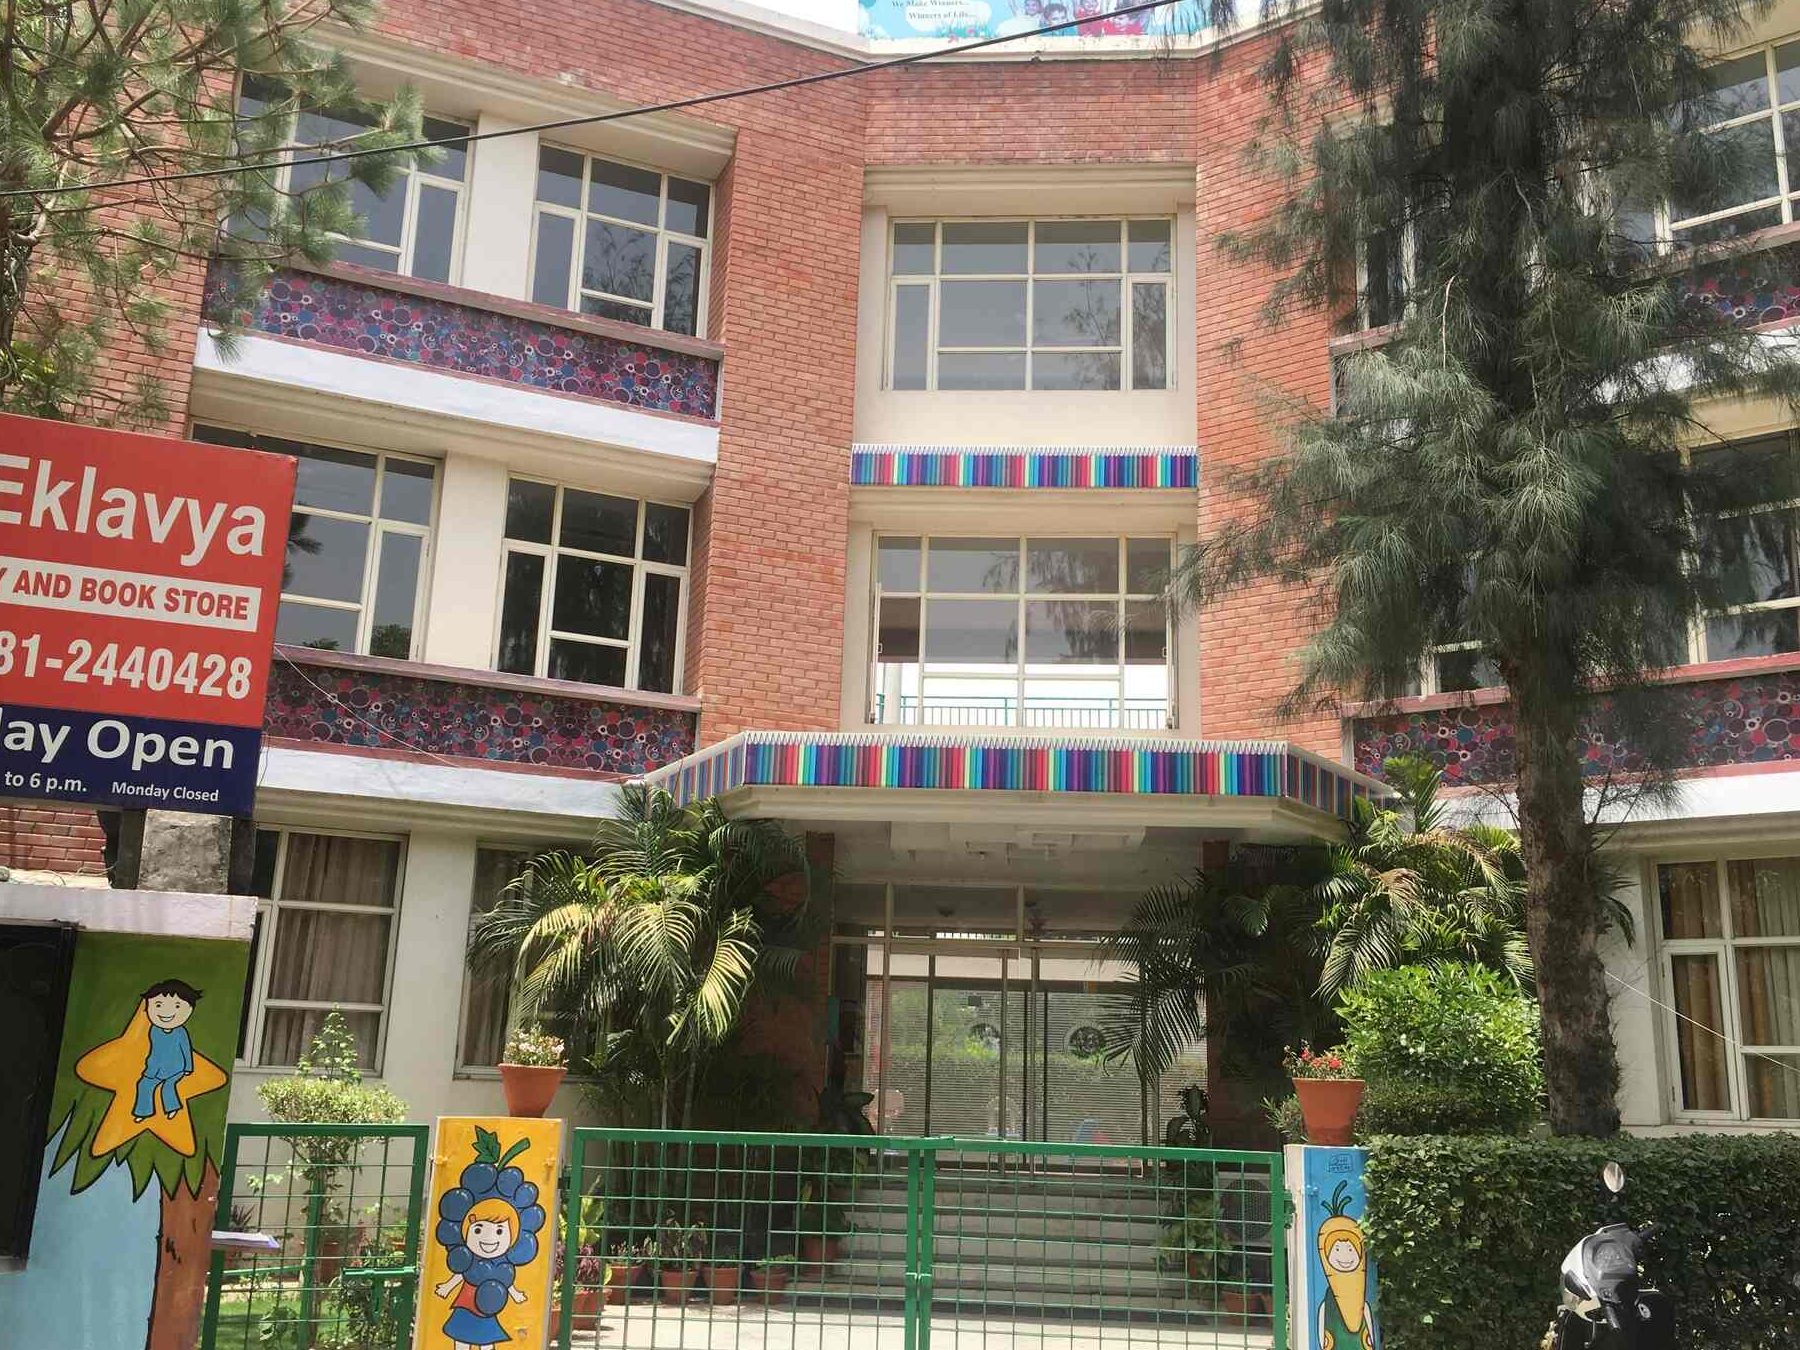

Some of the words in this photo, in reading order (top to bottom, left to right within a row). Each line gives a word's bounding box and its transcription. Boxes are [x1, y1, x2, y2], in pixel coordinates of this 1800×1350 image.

[0, 454, 266, 567] Eklavya
[13, 568, 72, 600] AND
[79, 577, 157, 611] BOOK
[164, 587, 250, 622] STORE
[0, 630, 252, 700] 81-2440428
[0, 706, 71, 765] ay
[87, 719, 234, 771] Open
[4, 771, 24, 788] to
[30, 773, 42, 789] 6
[46, 777, 88, 794] p.m.
[111, 781, 170, 801] Monday
[173, 786, 220, 803] Closed
